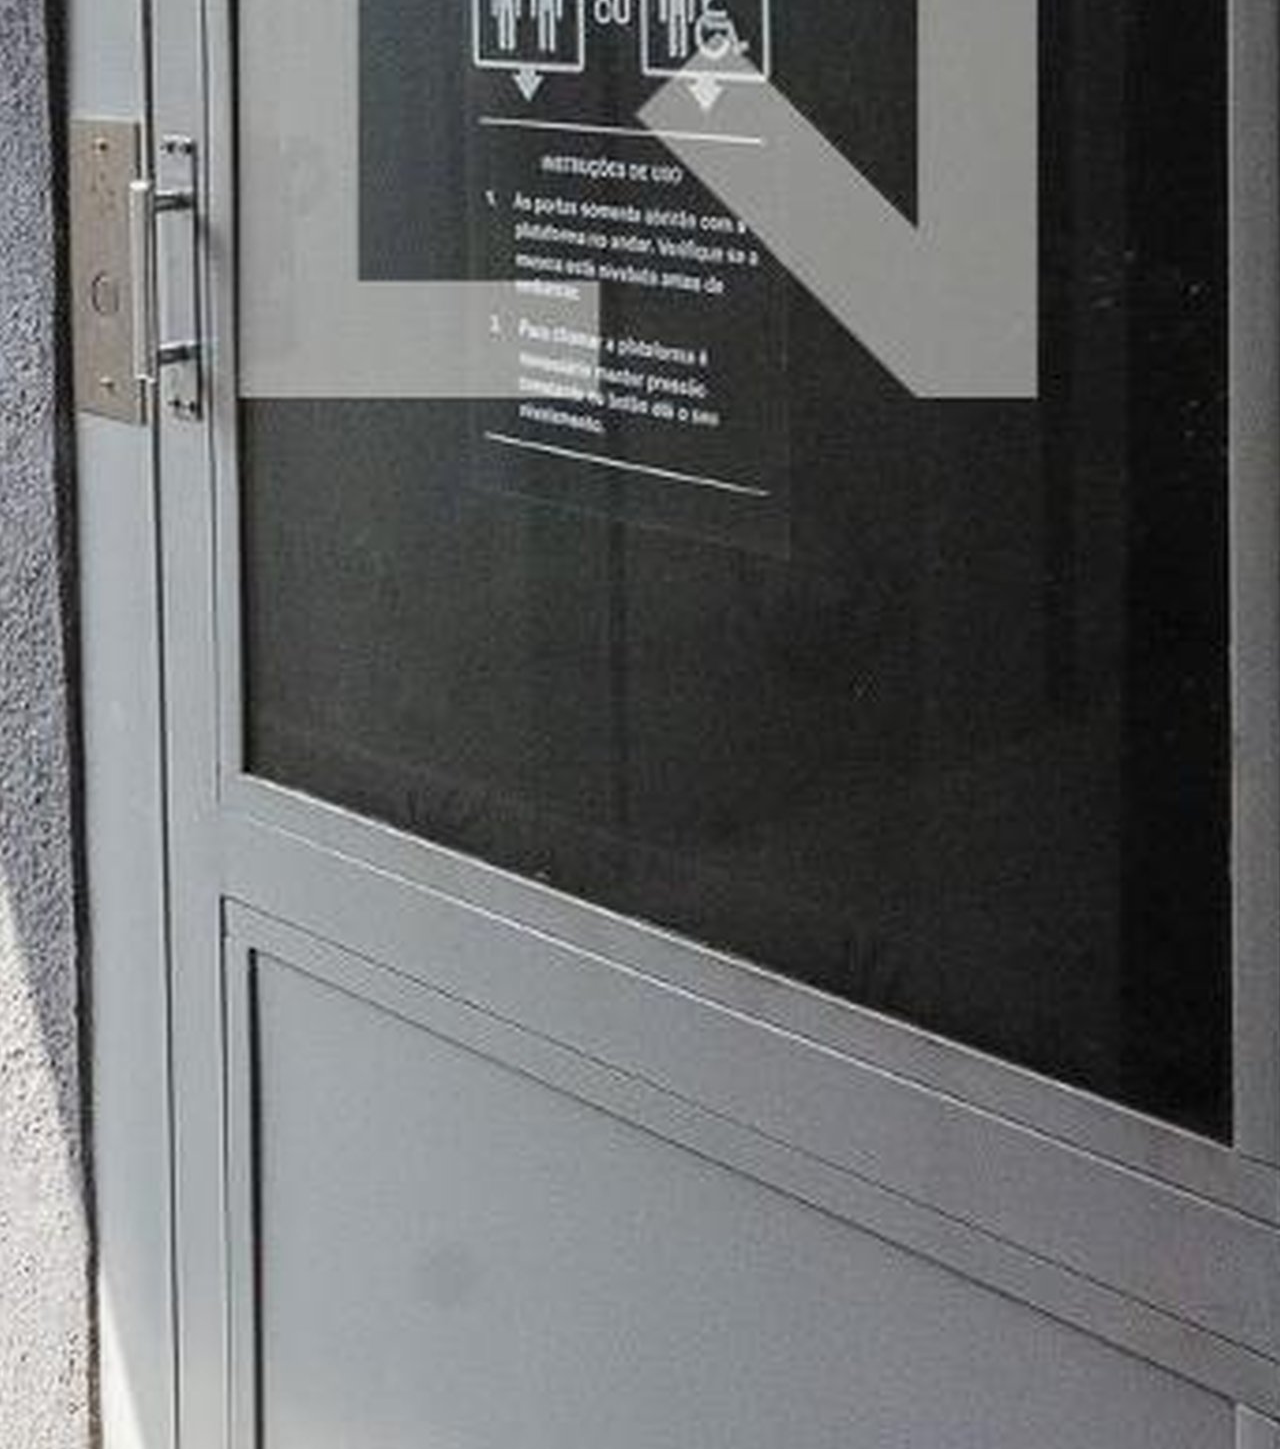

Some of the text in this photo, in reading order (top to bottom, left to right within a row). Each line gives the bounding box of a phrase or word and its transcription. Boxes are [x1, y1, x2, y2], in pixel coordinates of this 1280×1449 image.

[628, 163, 649, 182] DE
[651, 164, 683, 185] USO
[513, 191, 532, 212] As
[534, 197, 578, 218] portas
[580, 202, 642, 223] somente
[700, 215, 734, 234] com
[514, 222, 586, 246] plataforma
[617, 335, 696, 365] plataforma
[677, 407, 689, 422] o
